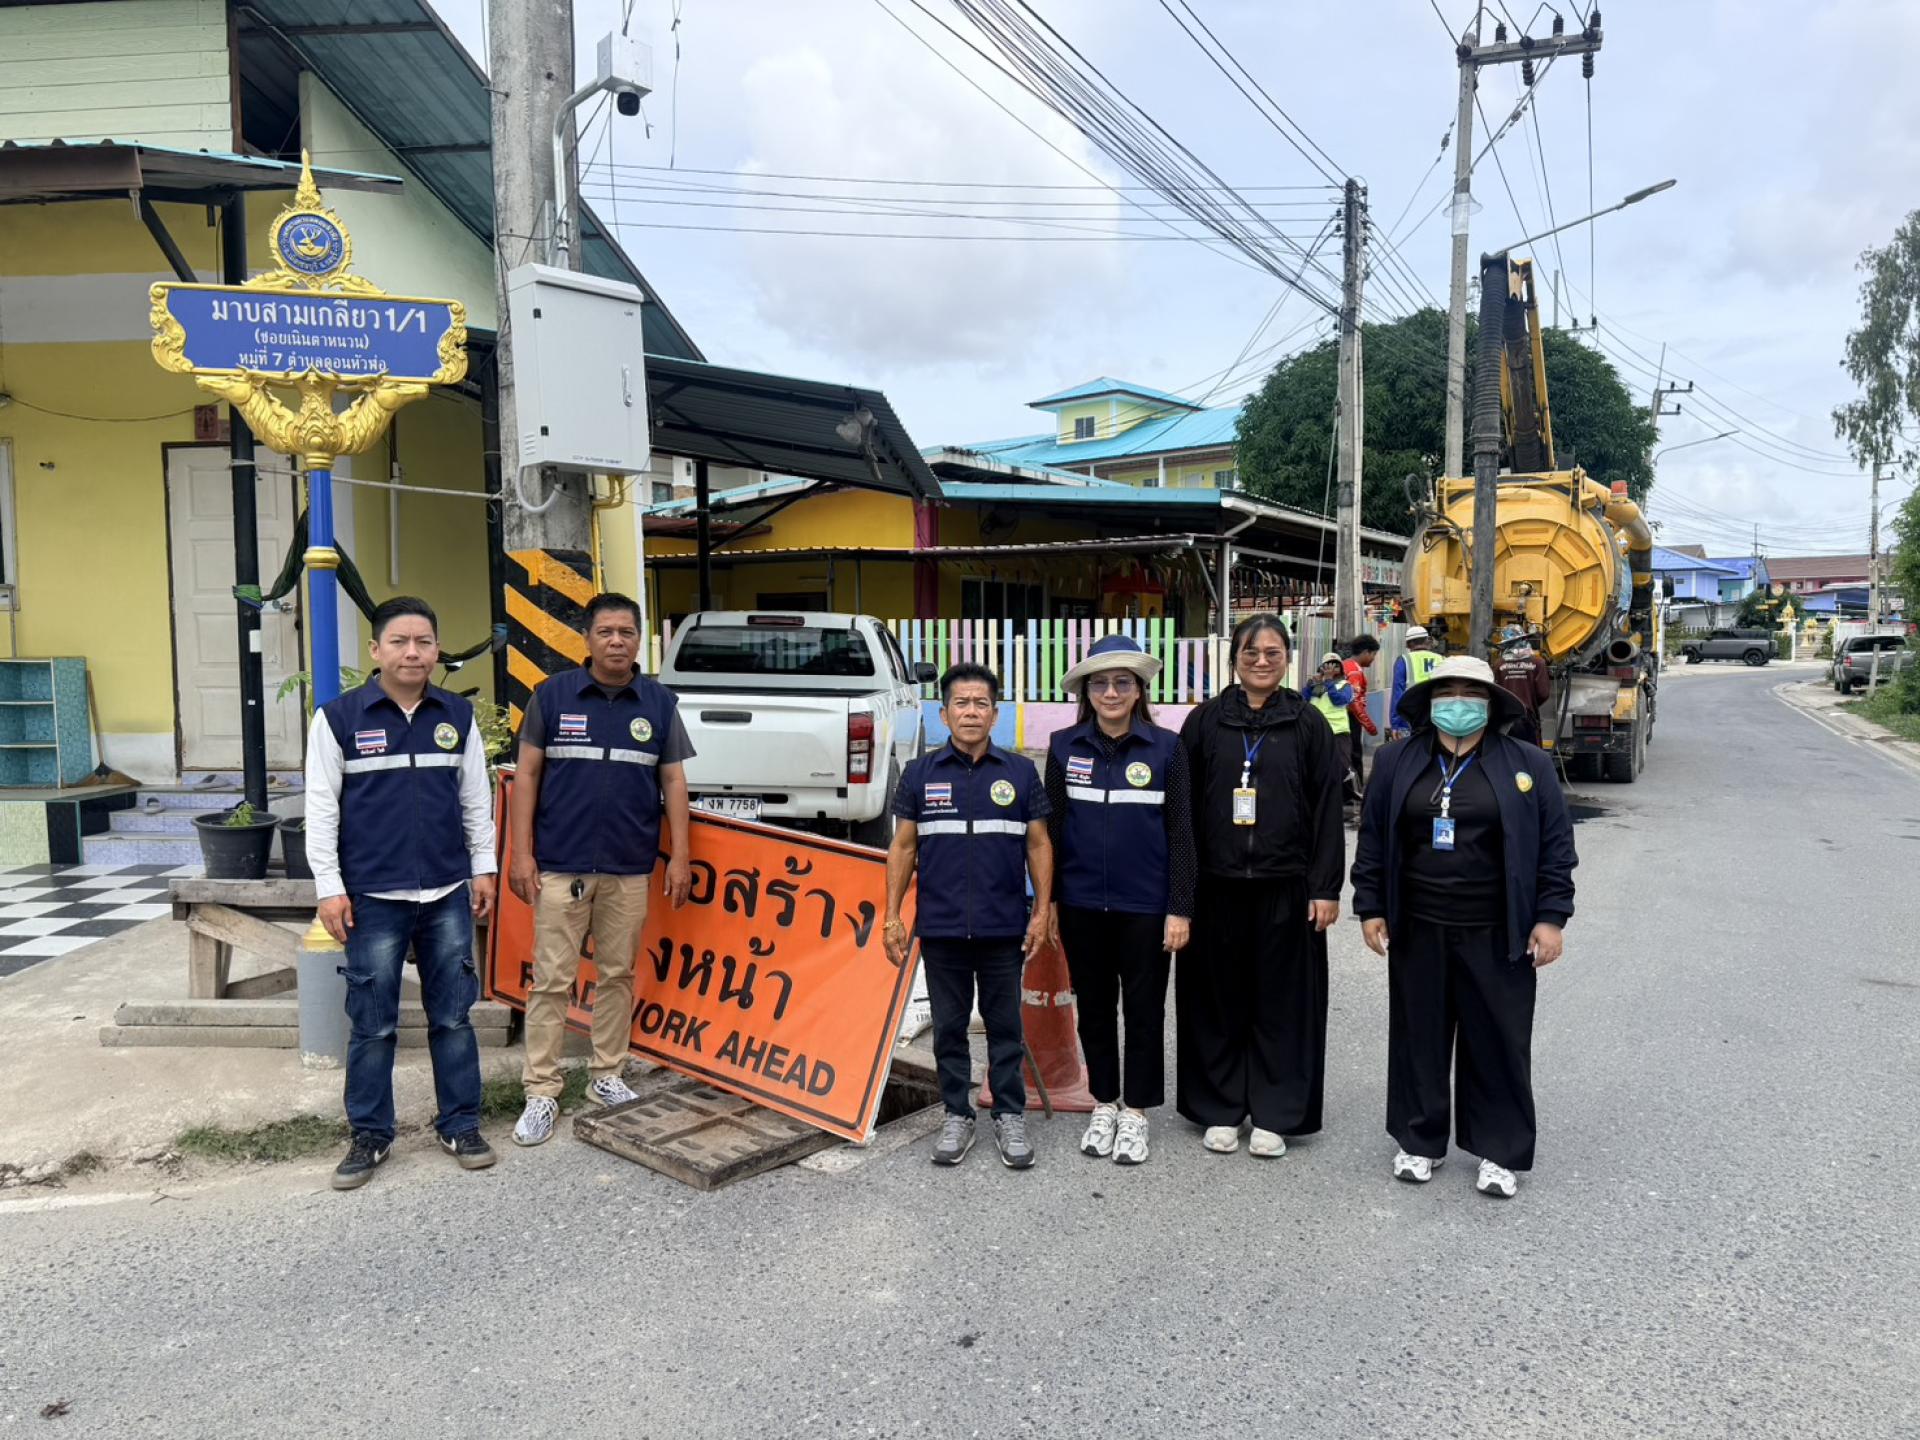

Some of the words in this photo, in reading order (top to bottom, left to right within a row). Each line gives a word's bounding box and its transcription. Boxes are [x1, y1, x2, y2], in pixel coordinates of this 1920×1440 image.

[211, 298, 381, 330] มาบสามเกลียว
[384, 307, 427, 333] 1/1
[238, 346, 268, 370] หมู่ที่
[271, 351, 283, 367] 7
[730, 799, 756, 811] 7758
[658, 850, 876, 948] อสร้าง
[715, 1030, 836, 1096] AHEAD
